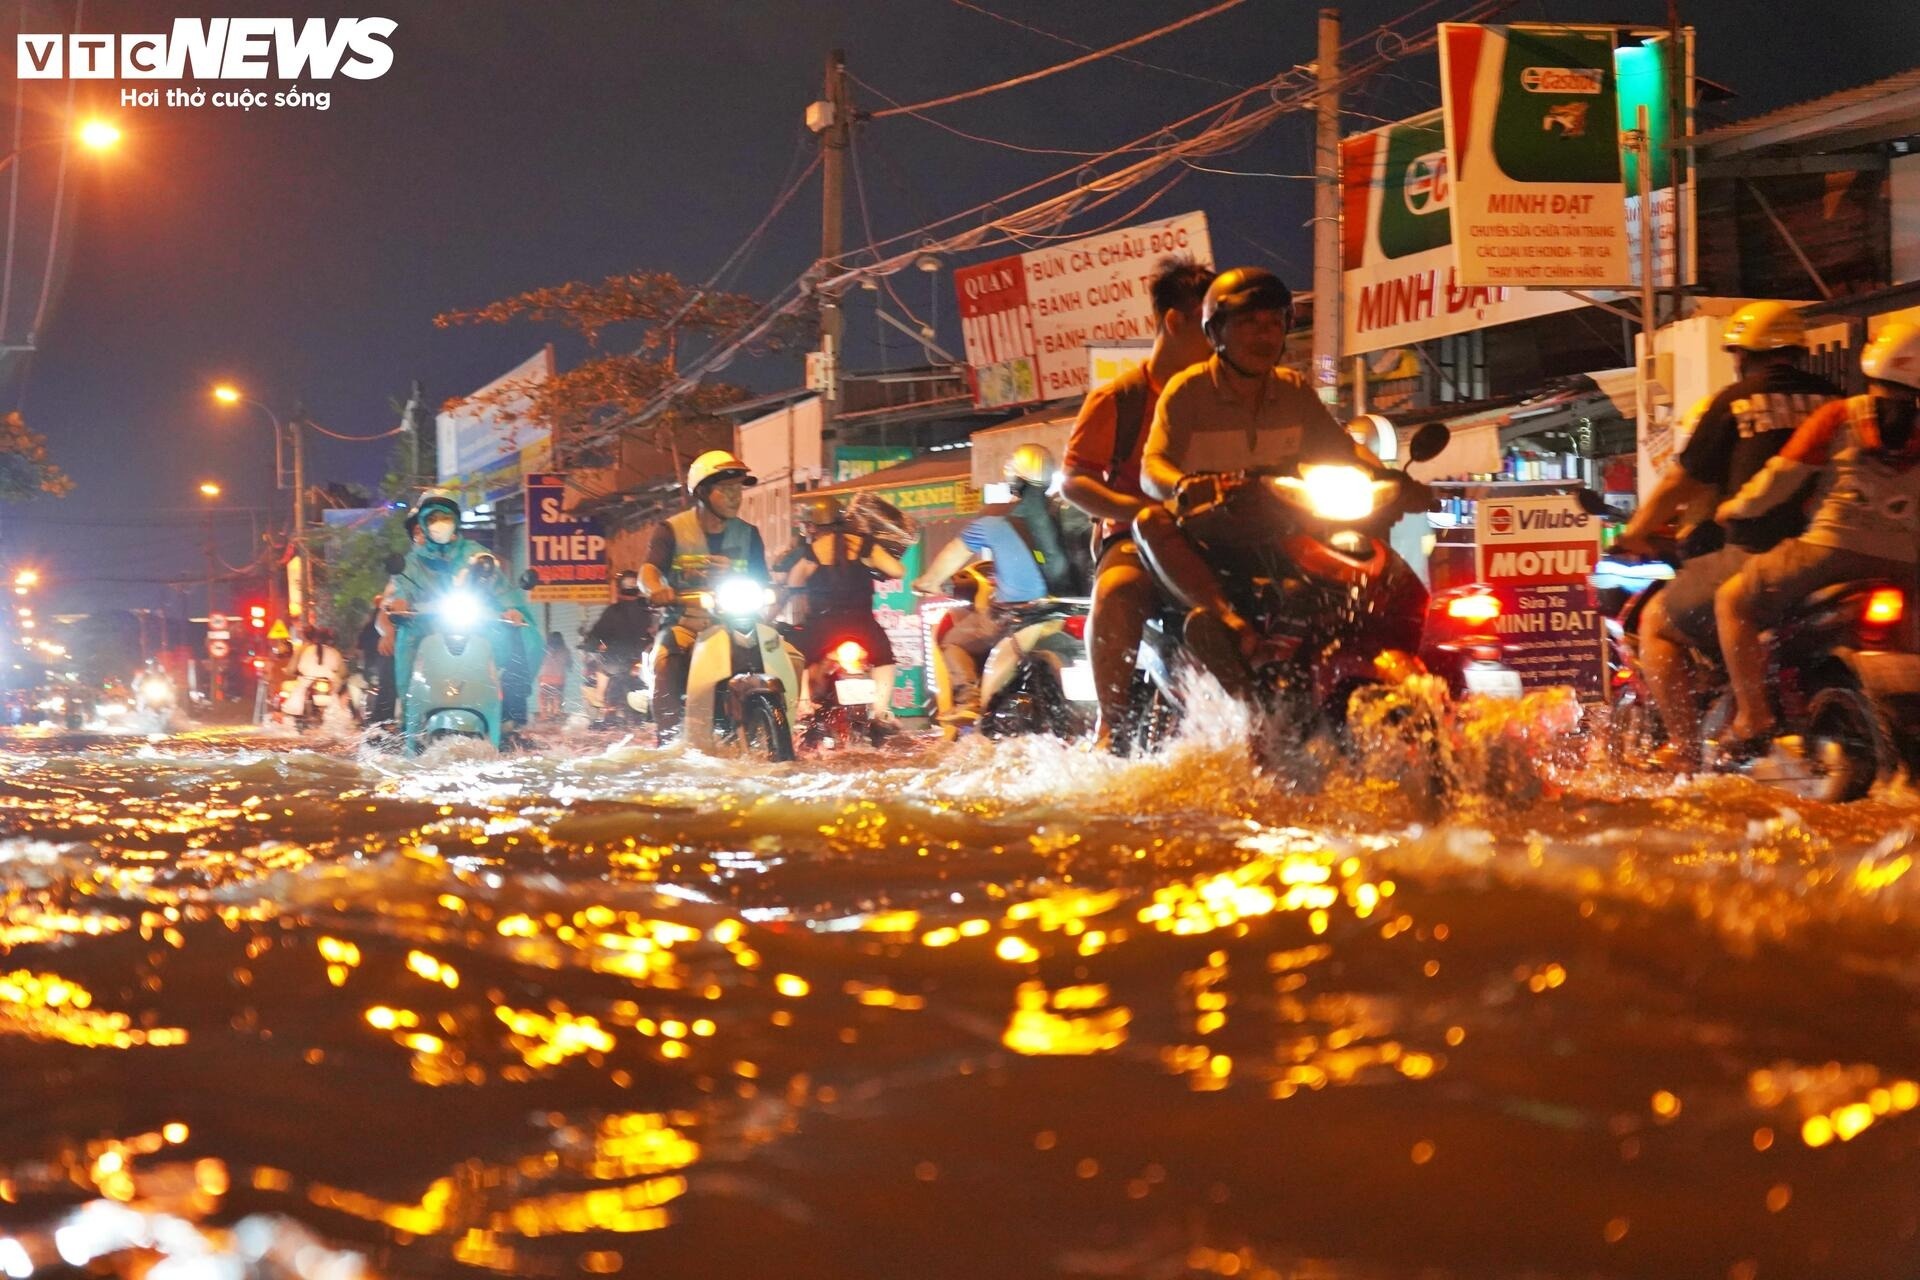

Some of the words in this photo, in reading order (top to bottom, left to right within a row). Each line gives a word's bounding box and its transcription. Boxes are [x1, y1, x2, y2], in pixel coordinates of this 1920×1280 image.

[1487, 194, 1546, 214] MINH
[1551, 194, 1594, 220] ĐẠT
[1356, 269, 1437, 333] MINH
[1518, 508, 1589, 530] Vilube
[531, 529, 606, 561] THÉP
[1488, 549, 1593, 578] MOTUL
[1550, 610, 1597, 635] ĐẠT
